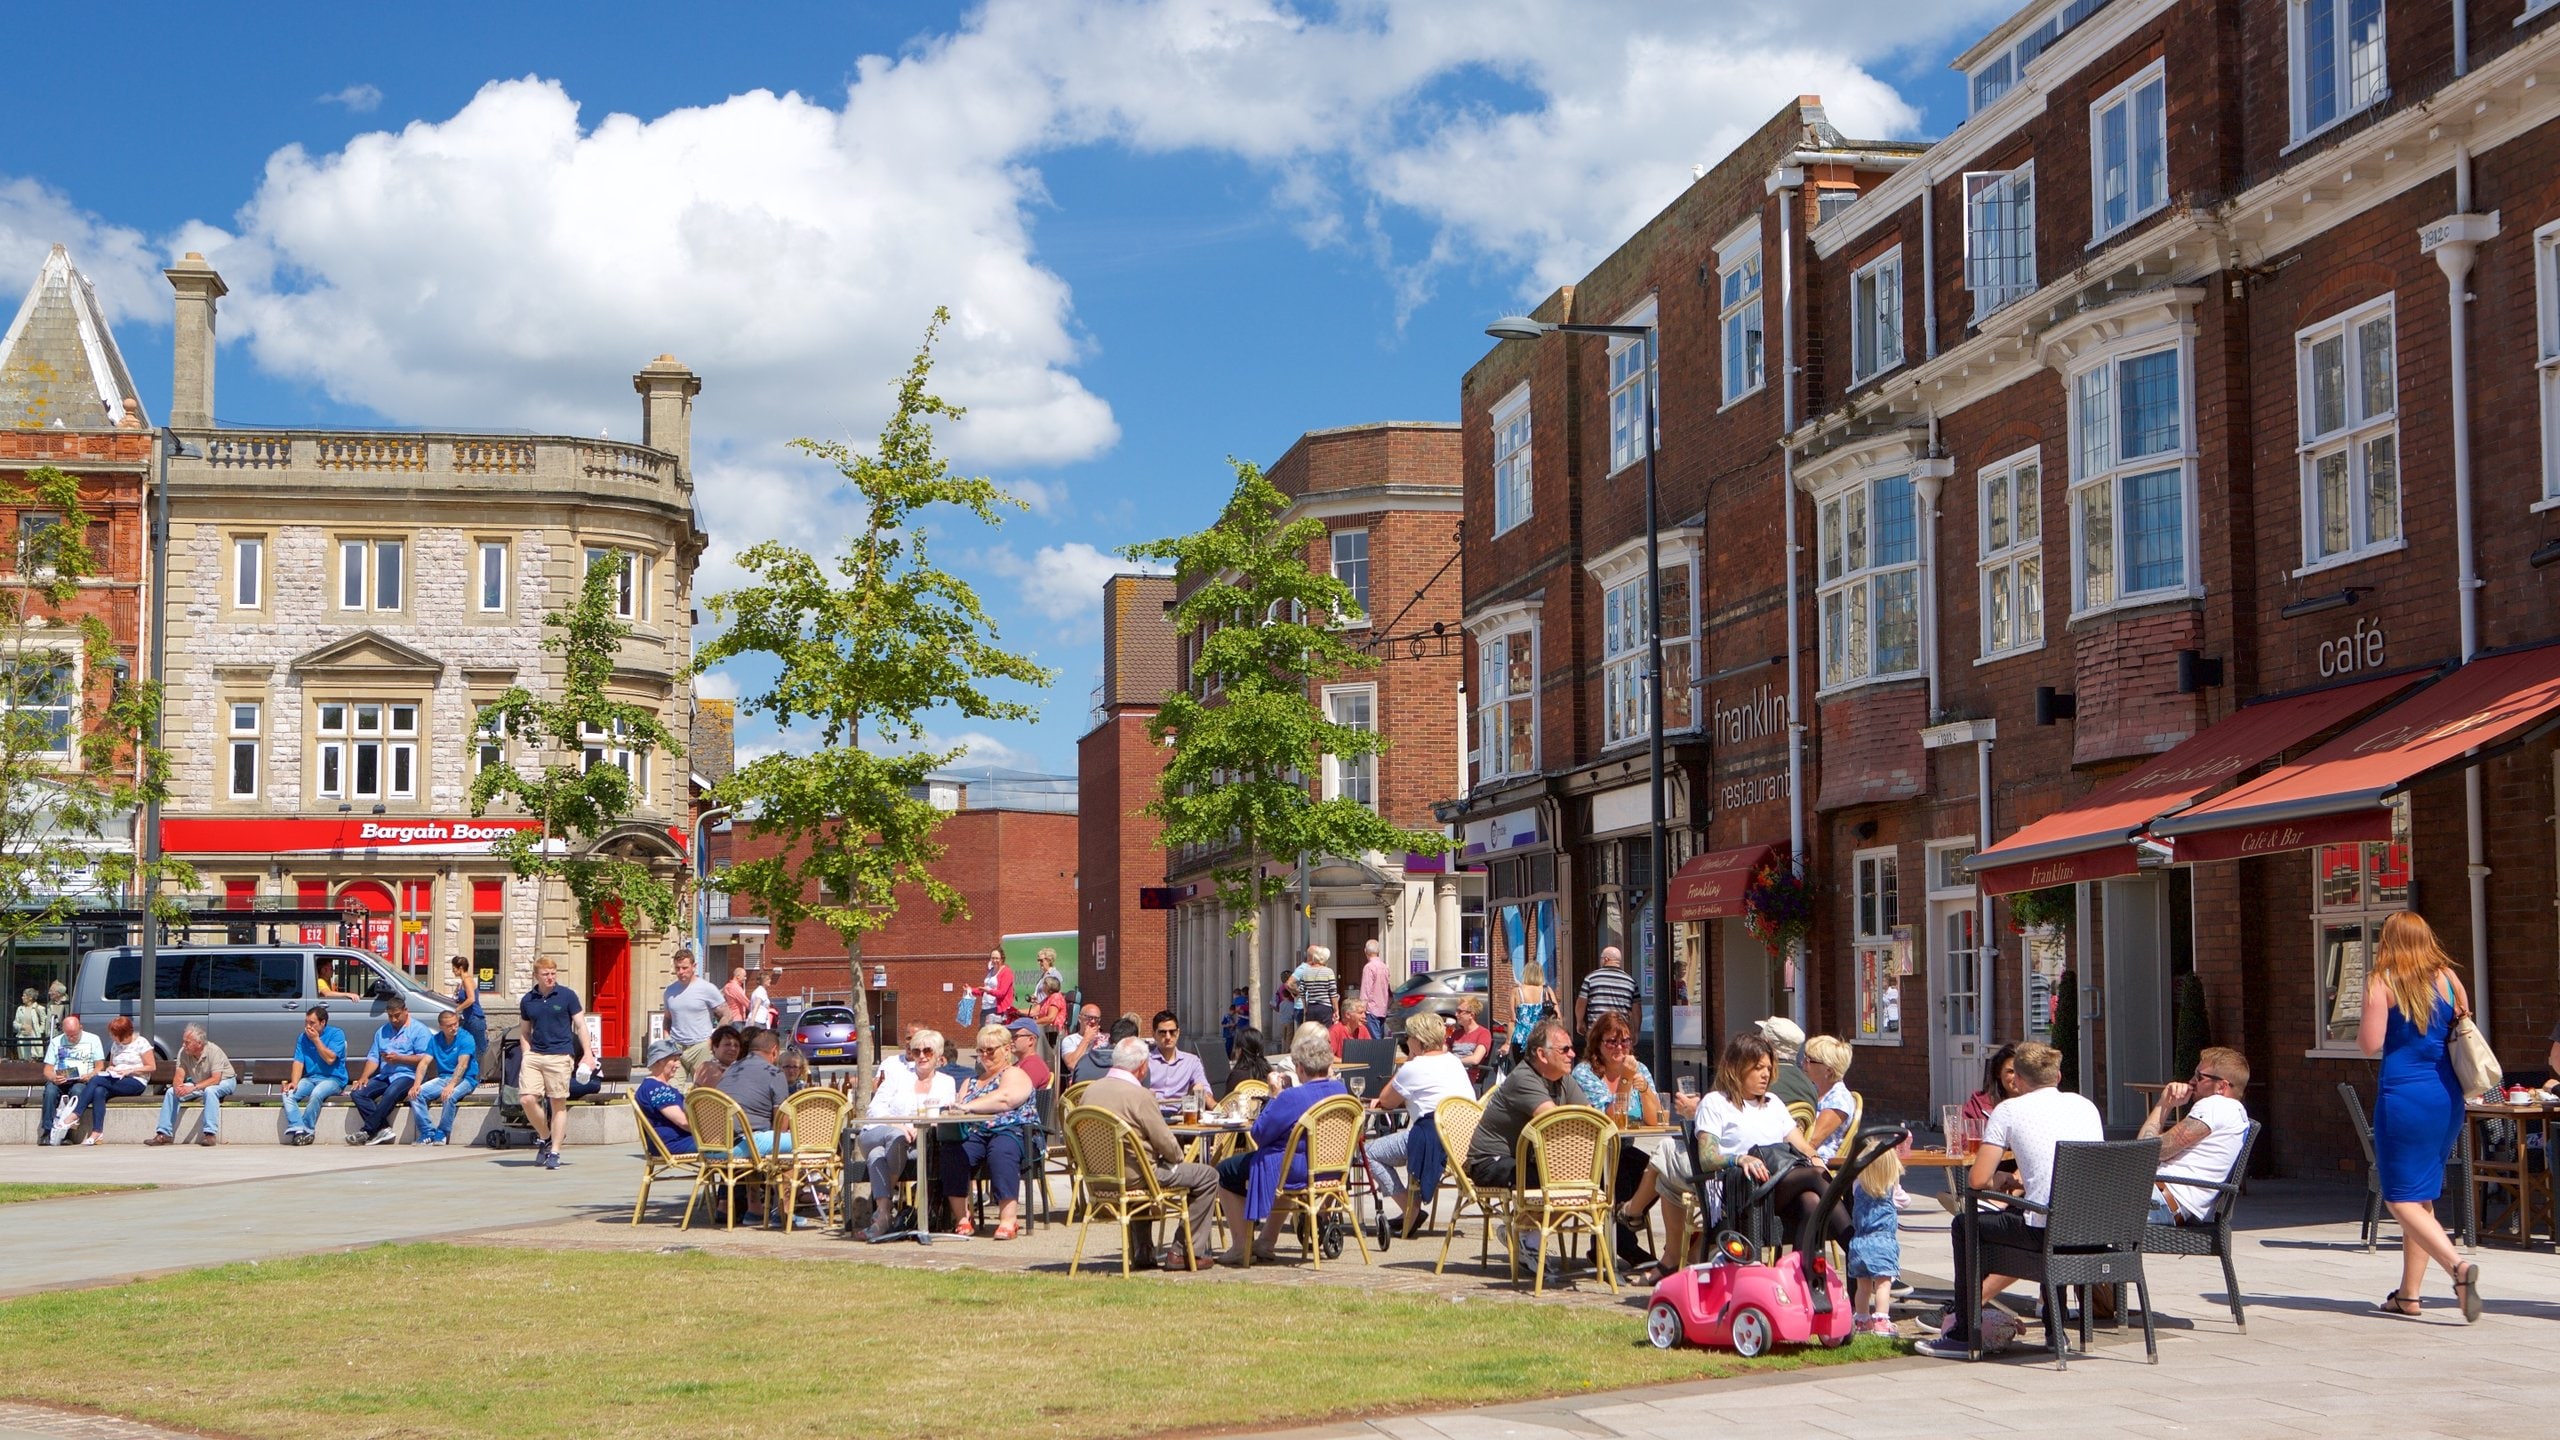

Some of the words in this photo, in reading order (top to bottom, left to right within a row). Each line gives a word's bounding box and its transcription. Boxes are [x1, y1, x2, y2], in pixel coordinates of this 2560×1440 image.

[2320, 616, 2384, 678] café
[1720, 766, 1792, 811] restaurant
[360, 822, 449, 843] Bargain
[451, 823, 517, 840] Booze
[2241, 831, 2268, 852] Café
[2280, 827, 2305, 846] Bar
[2030, 862, 2075, 885] Franklins
[1687, 880, 1722, 900] Franklins
[307, 929, 322, 941] £12
